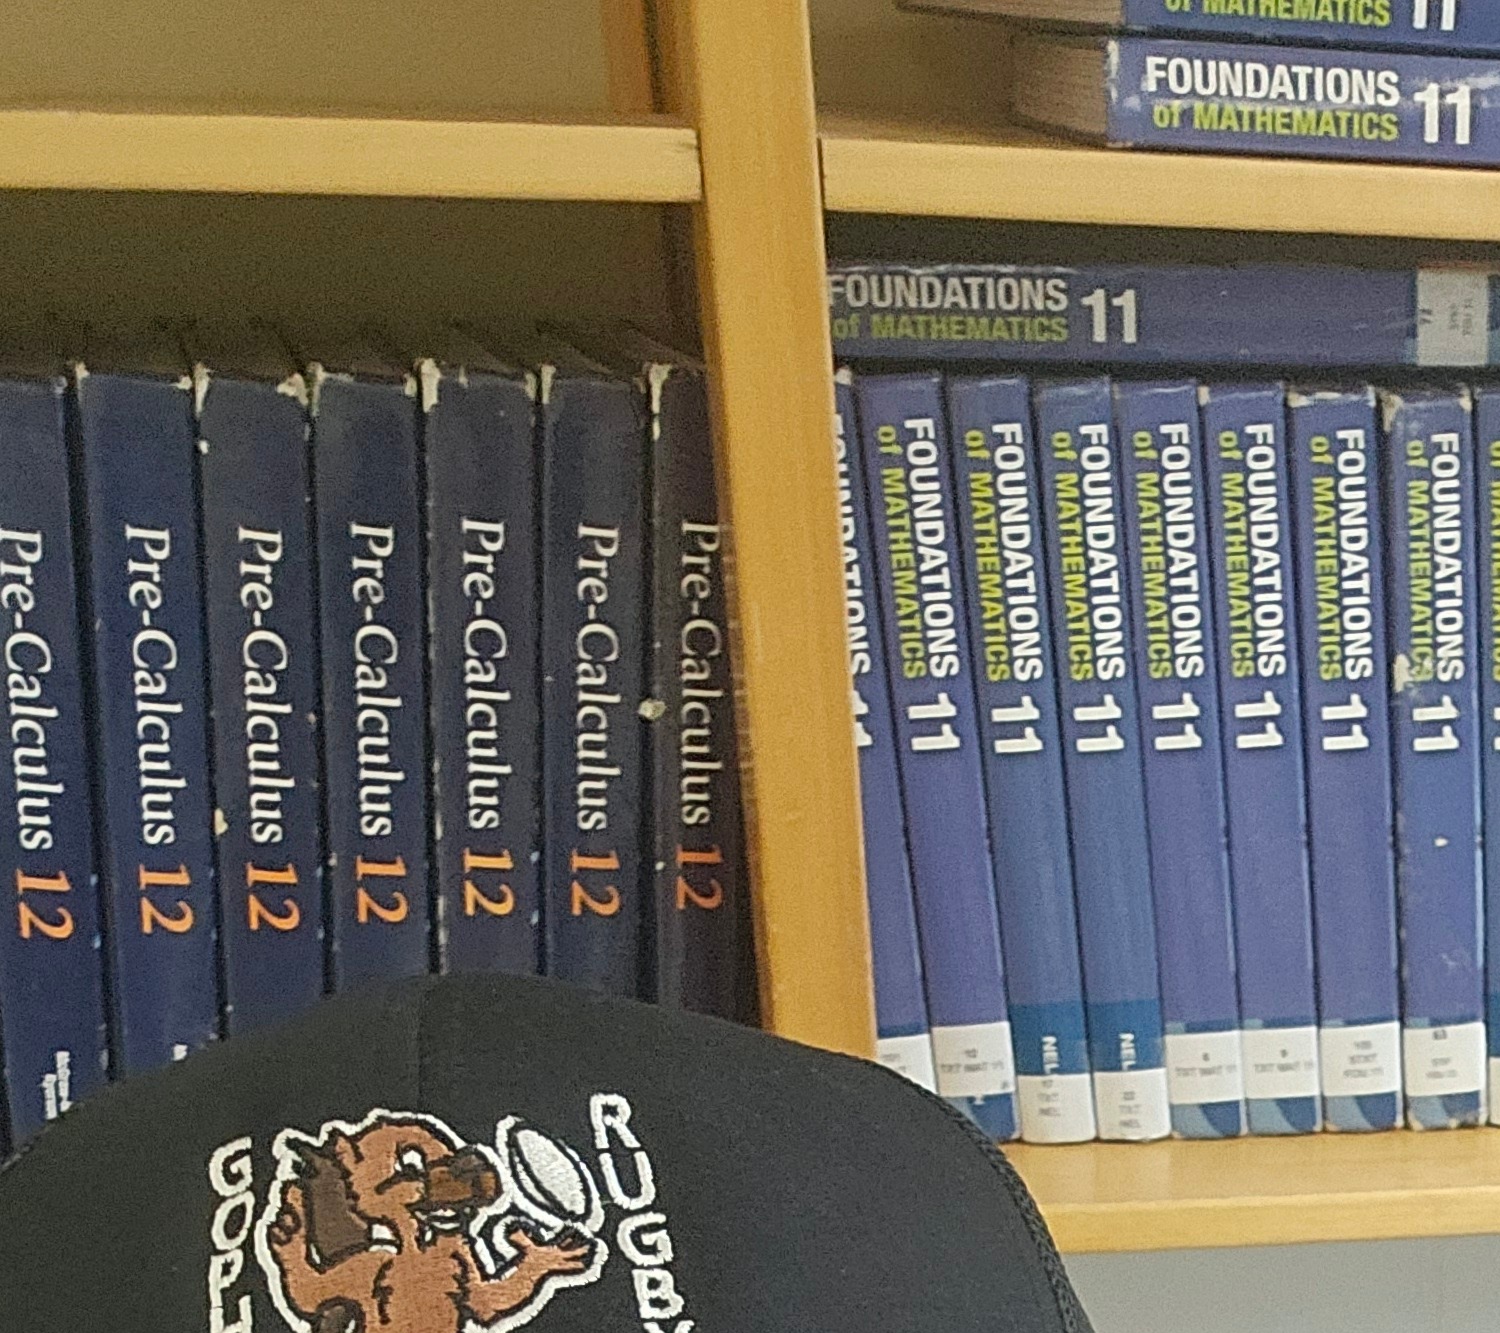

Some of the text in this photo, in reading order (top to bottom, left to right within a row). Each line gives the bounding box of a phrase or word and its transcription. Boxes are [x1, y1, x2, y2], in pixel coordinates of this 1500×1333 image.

[1145, 55, 1400, 107] FOUNDATIONS
[1153, 103, 1399, 141] of MATHEMATICS
[1200, 0, 1391, 27] MATHEMATICS
[1414, 82, 1471, 145] 11
[828, 274, 1068, 311] FOUNDATIONS
[833, 313, 1069, 342] of MATHEMATICS
[1081, 289, 1137, 343] 11
[878, 426, 926, 677] of MATHEMATICS
[905, 419, 959, 677] FOUNDATIONS
[966, 430, 1011, 681] of MATHEMATICS
[992, 423, 1043, 681] FOUNDATIONS
[1053, 432, 1094, 680] of MATHEMATICS
[1079, 424, 1125, 680] FOUNDATIONS
[1135, 432, 1172, 678] of MATHEMATICS
[1160, 424, 1204, 678] FOUNDATIONS
[1220, 432, 1254, 677] of MATHEMATICS
[1245, 424, 1286, 677] FOUNDATIONS
[1312, 437, 1342, 679] of MATHEMATICS
[1336, 429, 1372, 679] FOUNDATIONS
[1408, 442, 1433, 680] of MATHEMATICS
[1431, 433, 1464, 681] FOUNDATIONS
[0, 528, 74, 940] Pre-Calculus 12
[124, 525, 194, 935] Pre-Calculus 12
[238, 525, 301, 932] Pre-Calculus 12
[350, 522, 408, 925] Pre-Calculus 12
[461, 519, 516, 916] Pre-Calculus 12
[571, 523, 621, 917] Pre-Calculus 12
[675, 522, 724, 910] Pre-Calculus 12
[908, 693, 960, 750] 11
[992, 696, 1042, 752] 11
[1074, 694, 1124, 751] 11
[1153, 693, 1201, 750] 11
[1235, 691, 1283, 748] 11
[1322, 694, 1368, 750] 11
[1411, 695, 1459, 751] 11
